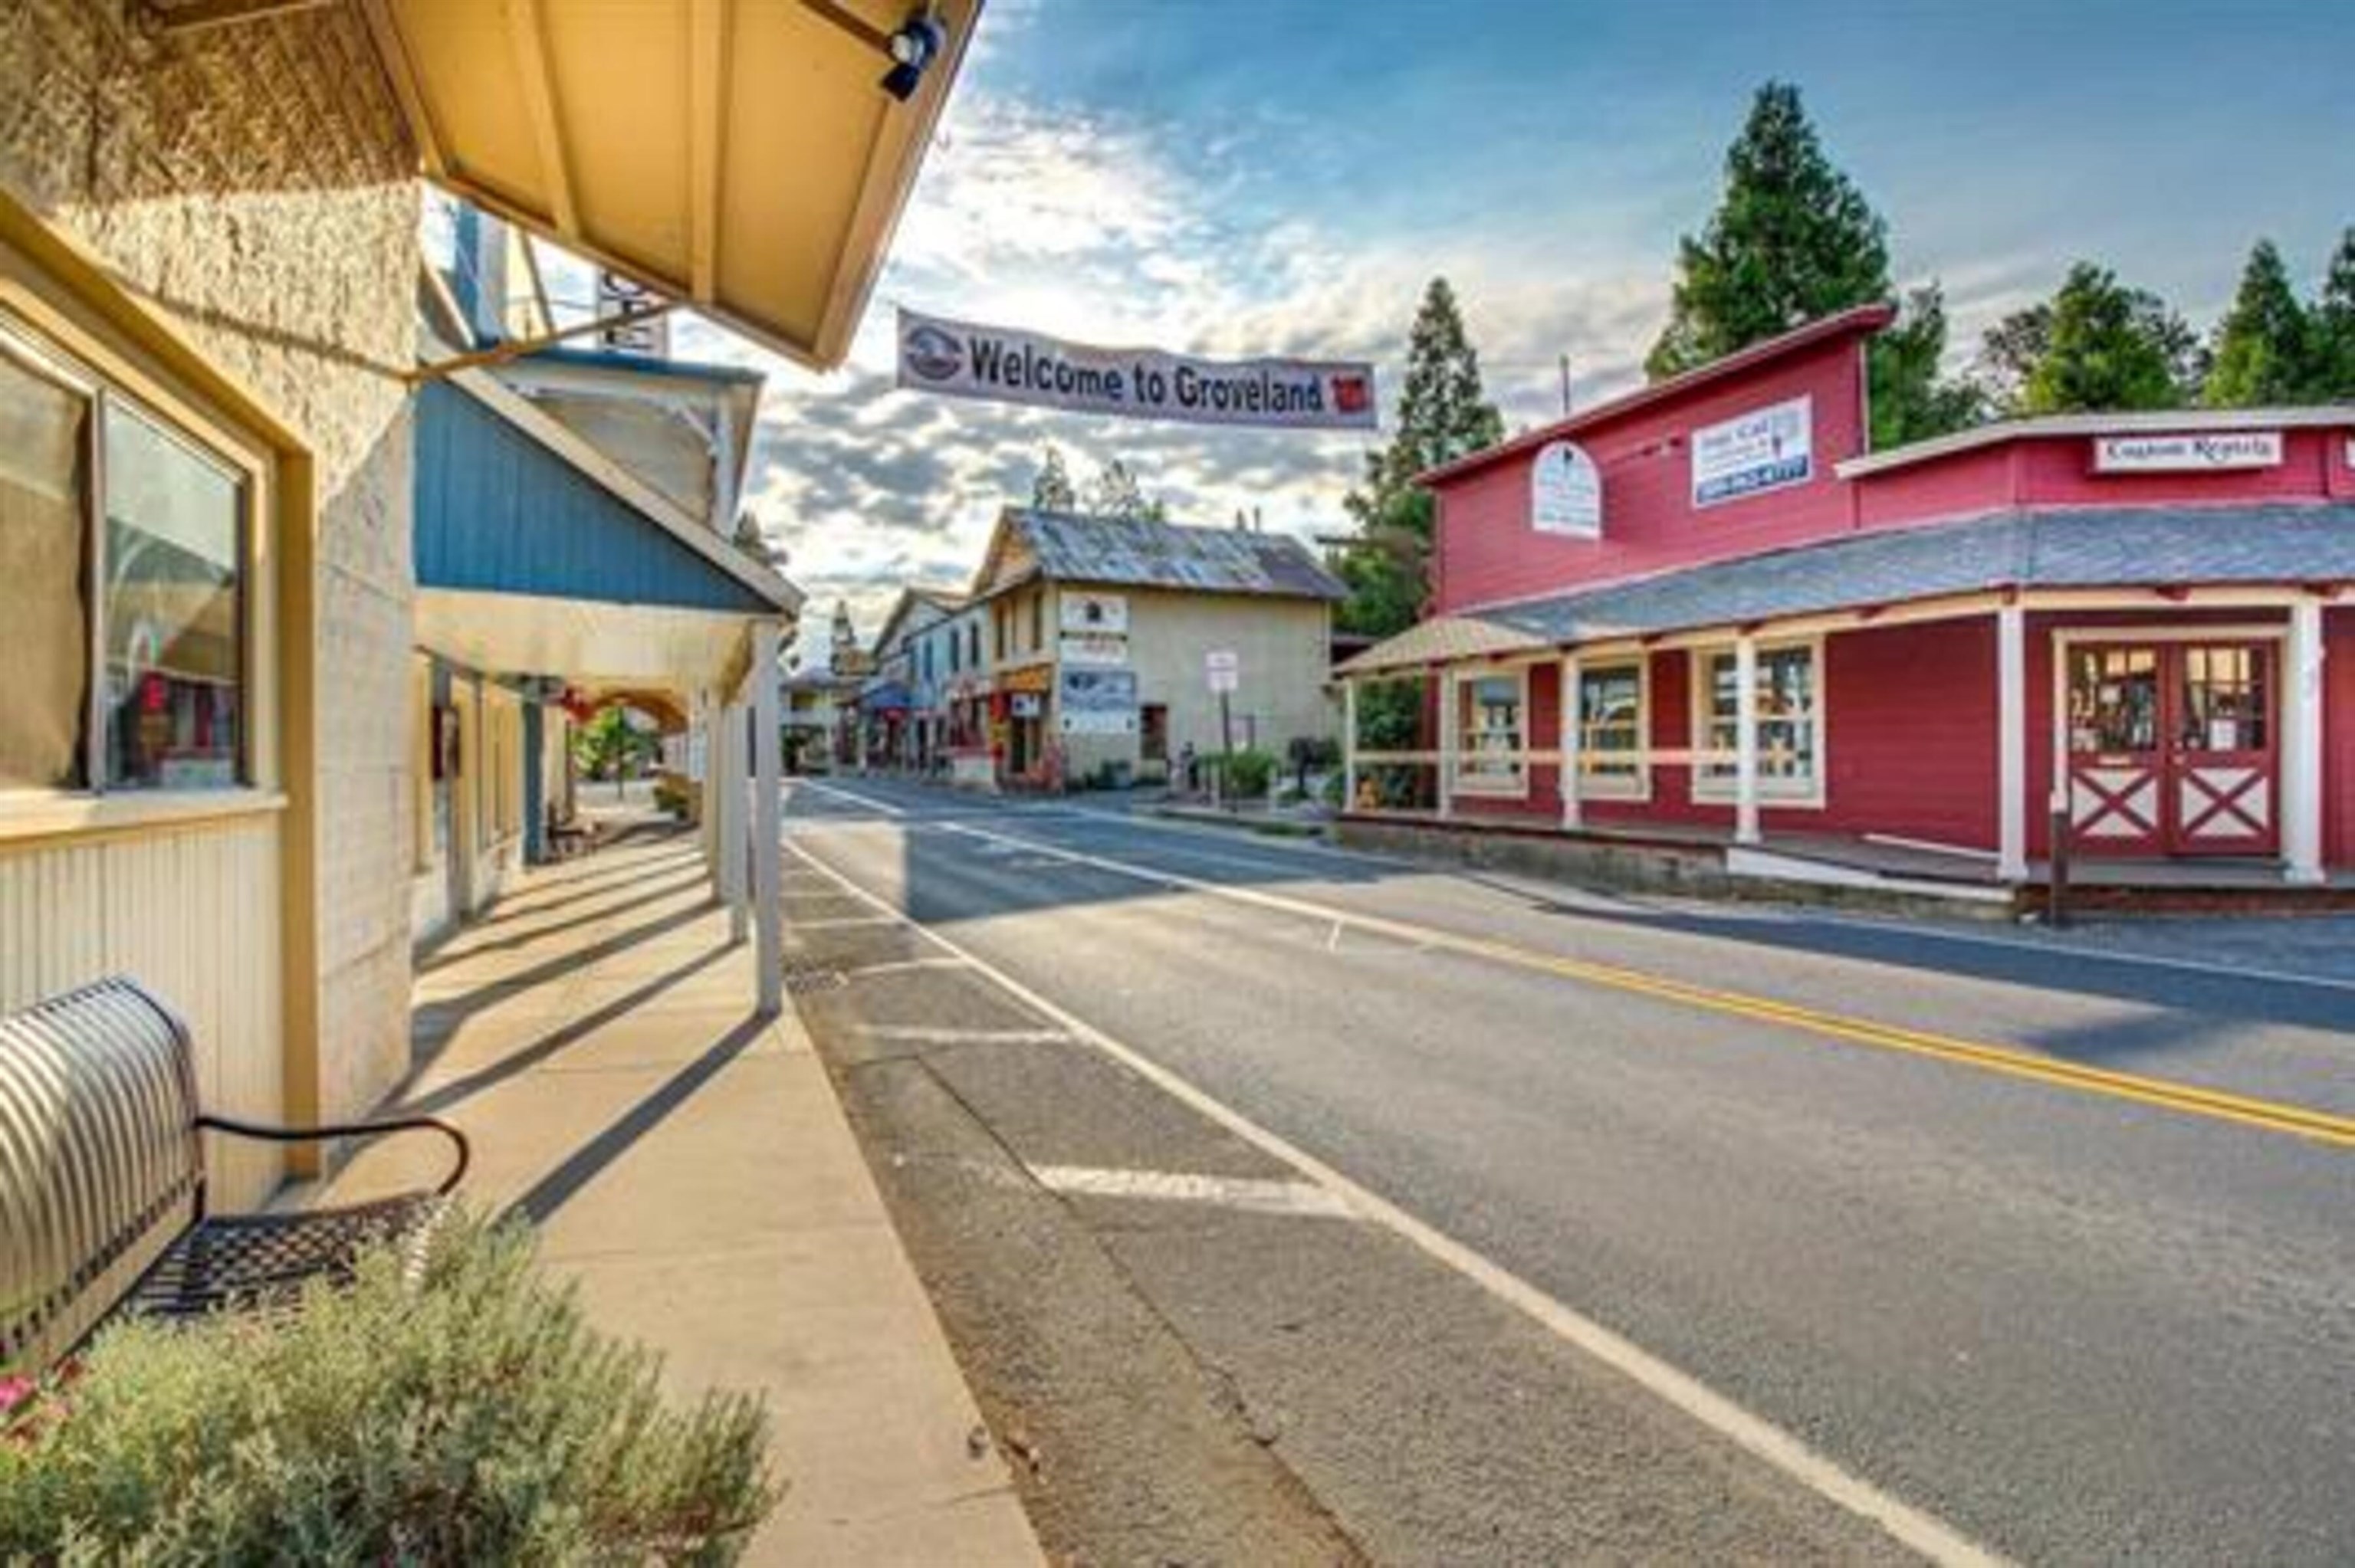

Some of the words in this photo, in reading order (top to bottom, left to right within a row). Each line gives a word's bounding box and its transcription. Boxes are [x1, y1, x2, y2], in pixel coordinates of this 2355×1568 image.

[969, 336, 1124, 400] Welcome
[1134, 362, 1166, 404] to
[1175, 366, 1323, 412] Groveland
